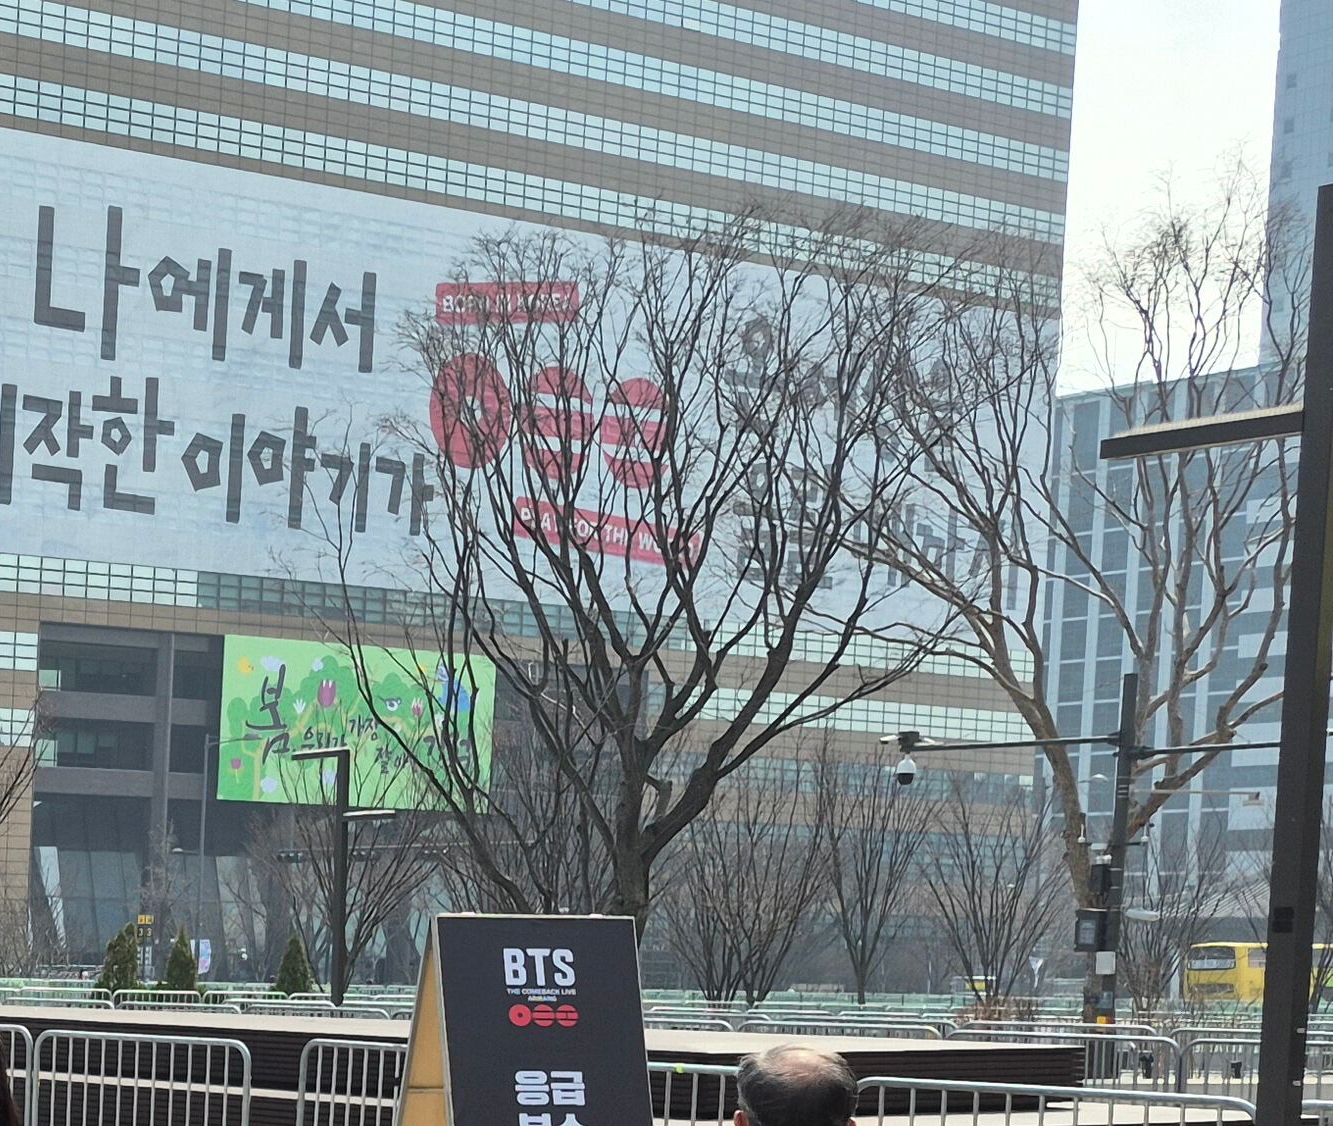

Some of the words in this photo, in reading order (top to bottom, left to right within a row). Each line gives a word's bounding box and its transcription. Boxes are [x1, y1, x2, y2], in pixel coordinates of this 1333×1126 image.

[34, 205, 376, 373] 나에게서
[181, 406, 433, 536] 이야기가
[503, 948, 575, 986] BTS
[521, 988, 561, 996] COMEBACK
[561, 988, 577, 996] LIVE
[515, 1070, 585, 1106] 응급
